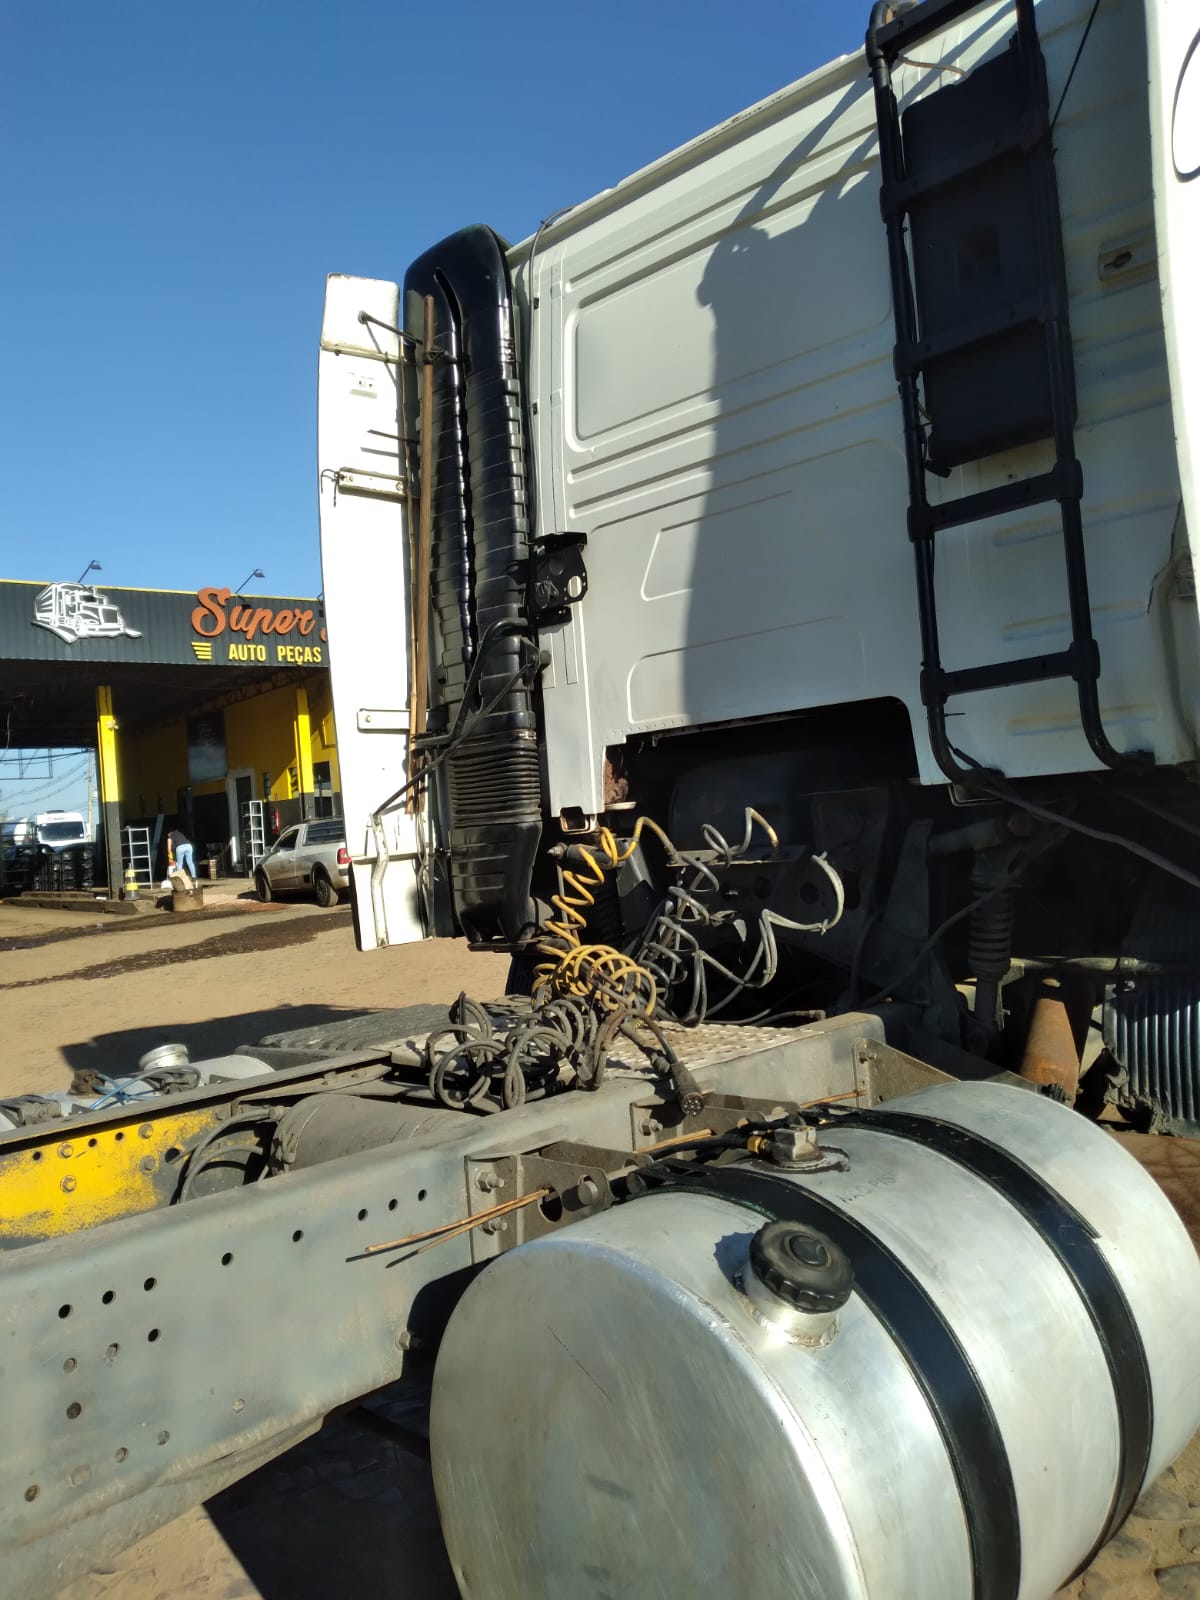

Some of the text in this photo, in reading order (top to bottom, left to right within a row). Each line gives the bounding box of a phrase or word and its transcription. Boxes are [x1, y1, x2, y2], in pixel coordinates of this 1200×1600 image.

[191, 587, 316, 641] Super
[228, 643, 322, 666] AUTO PEÇAS
